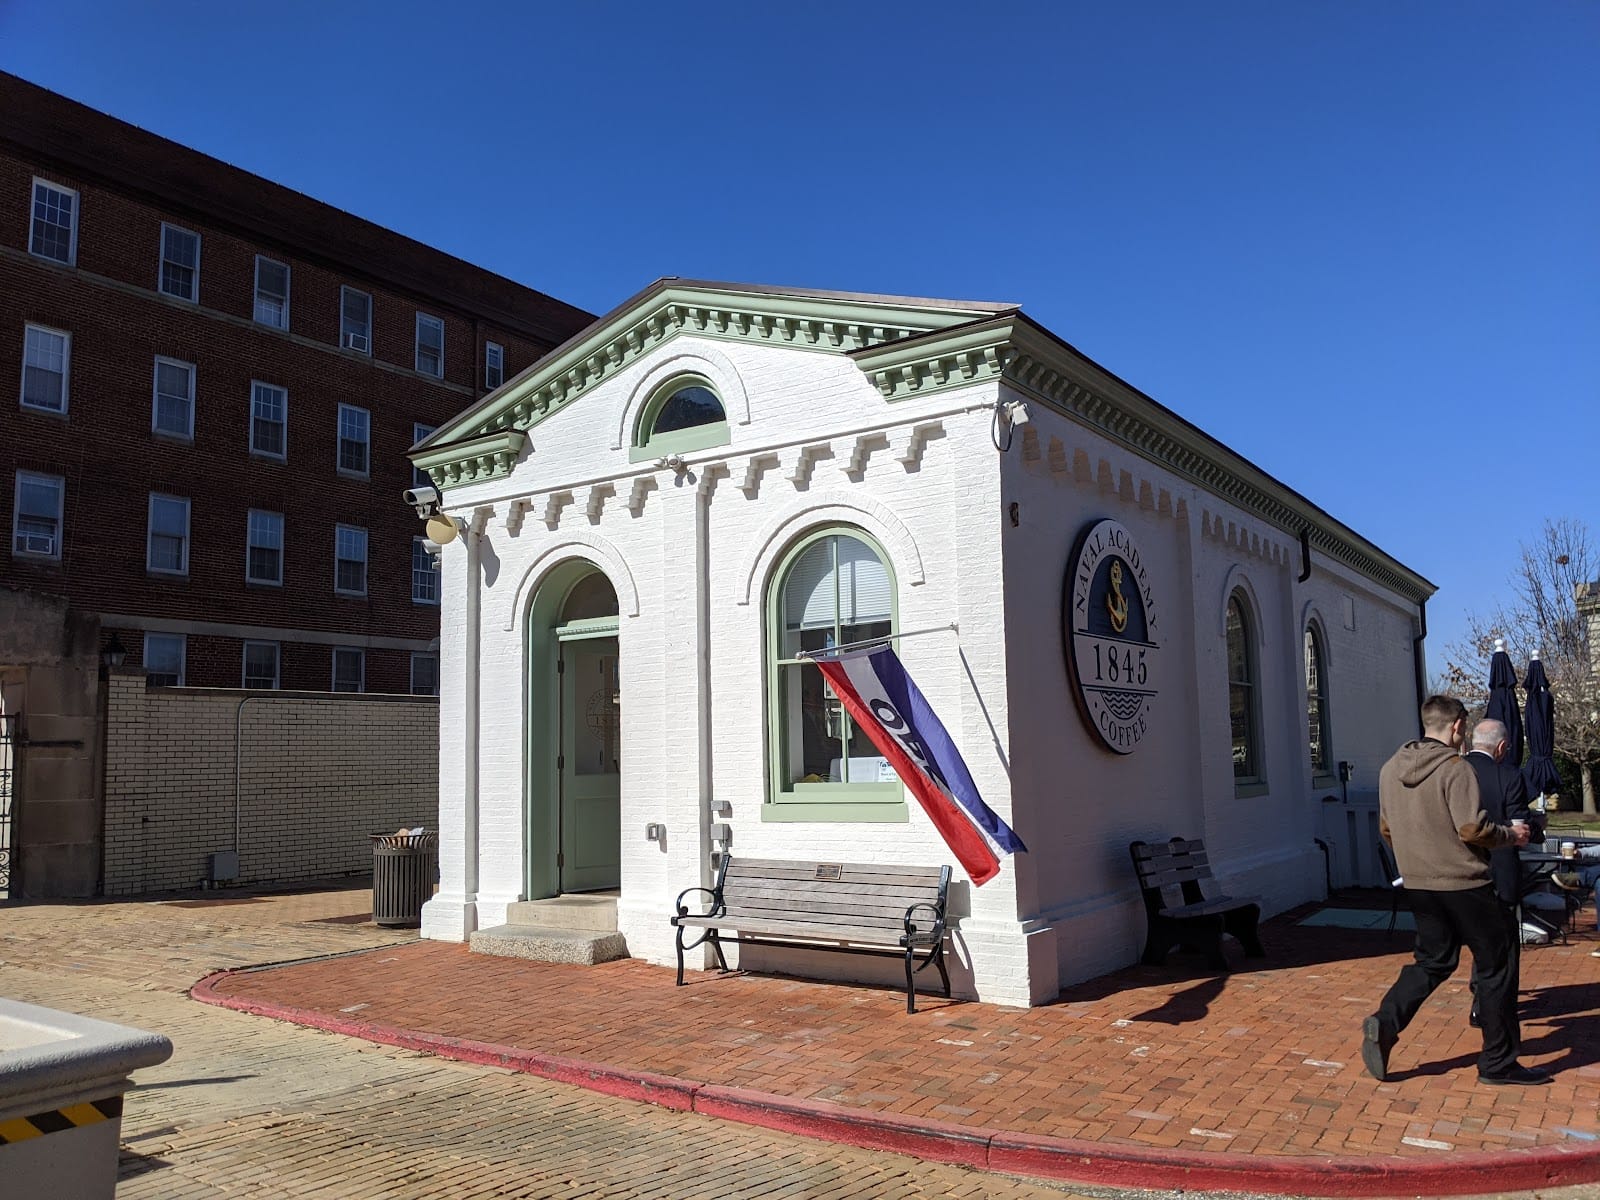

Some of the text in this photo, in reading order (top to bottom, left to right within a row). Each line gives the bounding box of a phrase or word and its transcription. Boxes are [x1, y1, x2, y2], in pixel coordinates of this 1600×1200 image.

[1076, 527, 1158, 631] NAVAL ACADEMY
[1093, 643, 1147, 685] 1845
[1100, 710, 1147, 747] COFFEE
